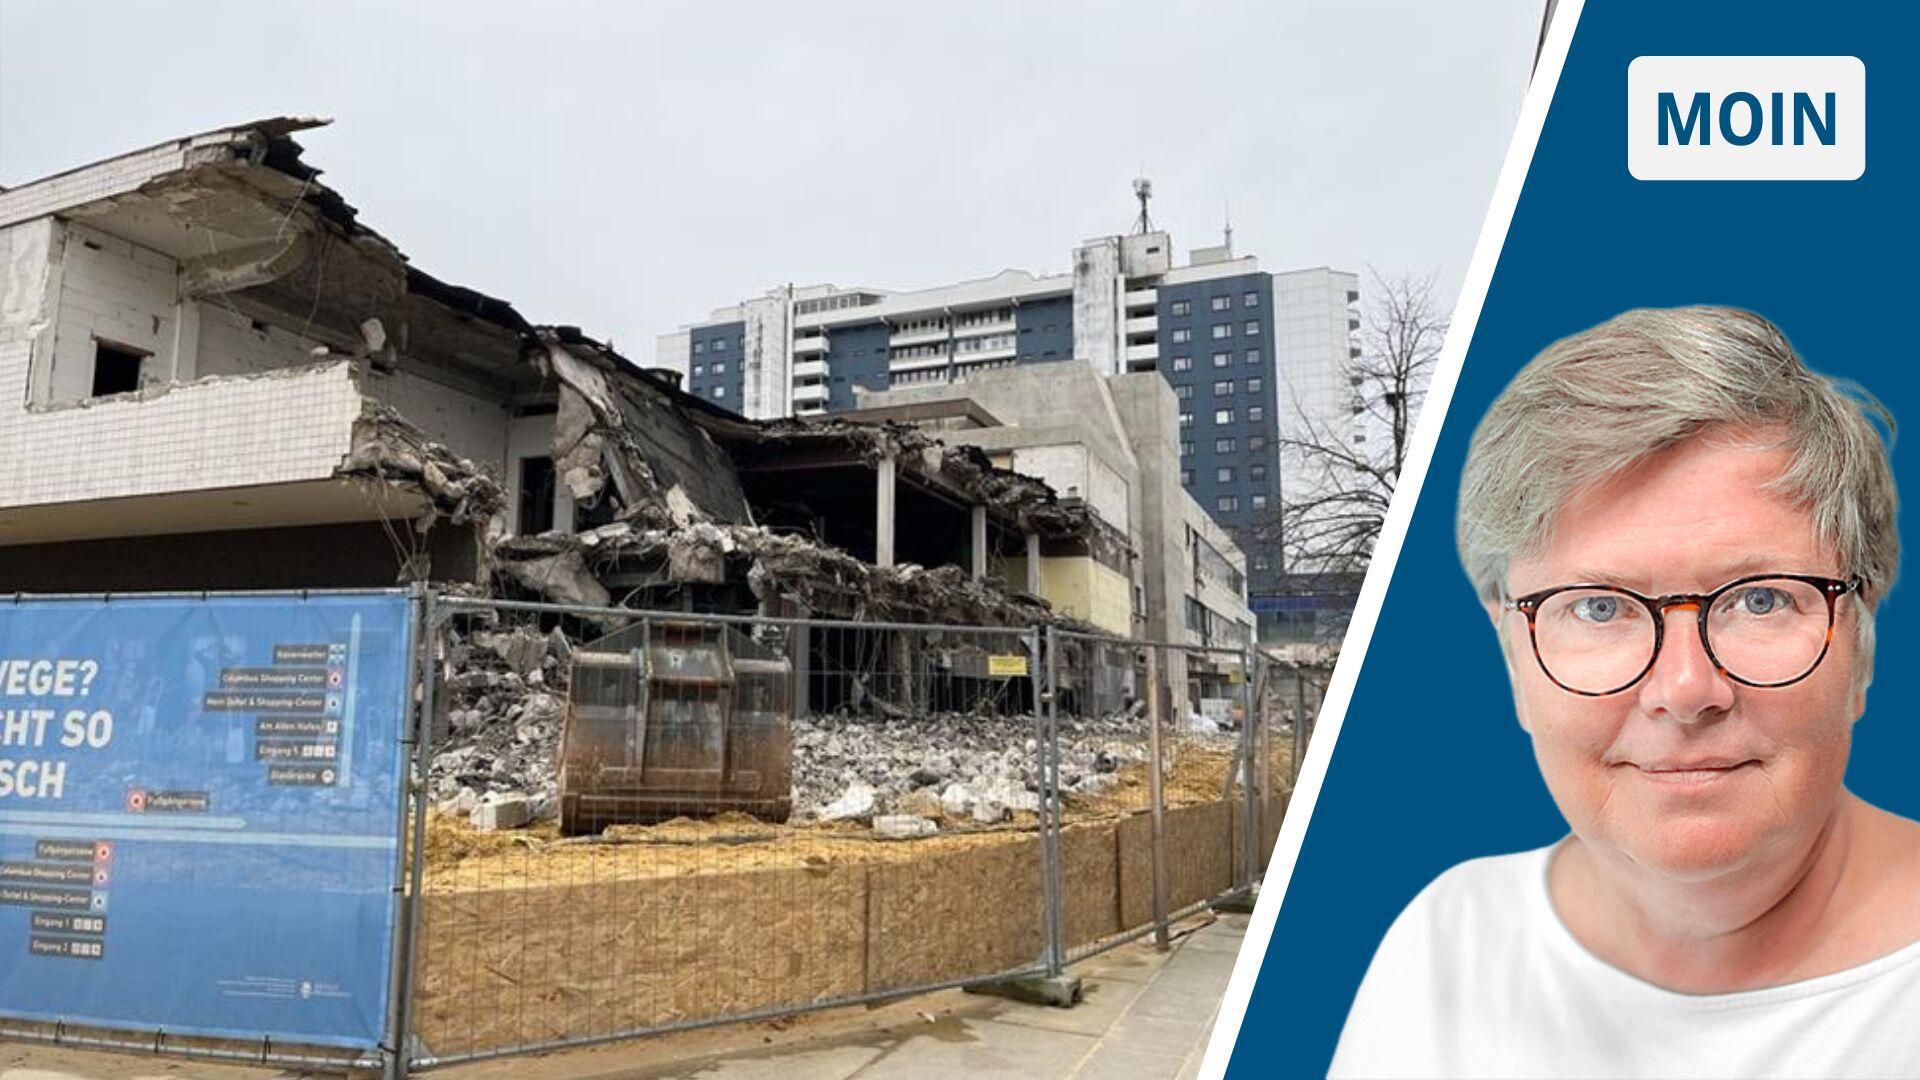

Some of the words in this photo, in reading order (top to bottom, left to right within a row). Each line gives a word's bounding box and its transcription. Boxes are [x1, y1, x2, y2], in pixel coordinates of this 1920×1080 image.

[260, 675, 296, 686] Shopping
[298, 675, 325, 684] Center
[0, 709, 55, 747] HT
[60, 709, 114, 749] SO
[0, 758, 67, 800] SCH
